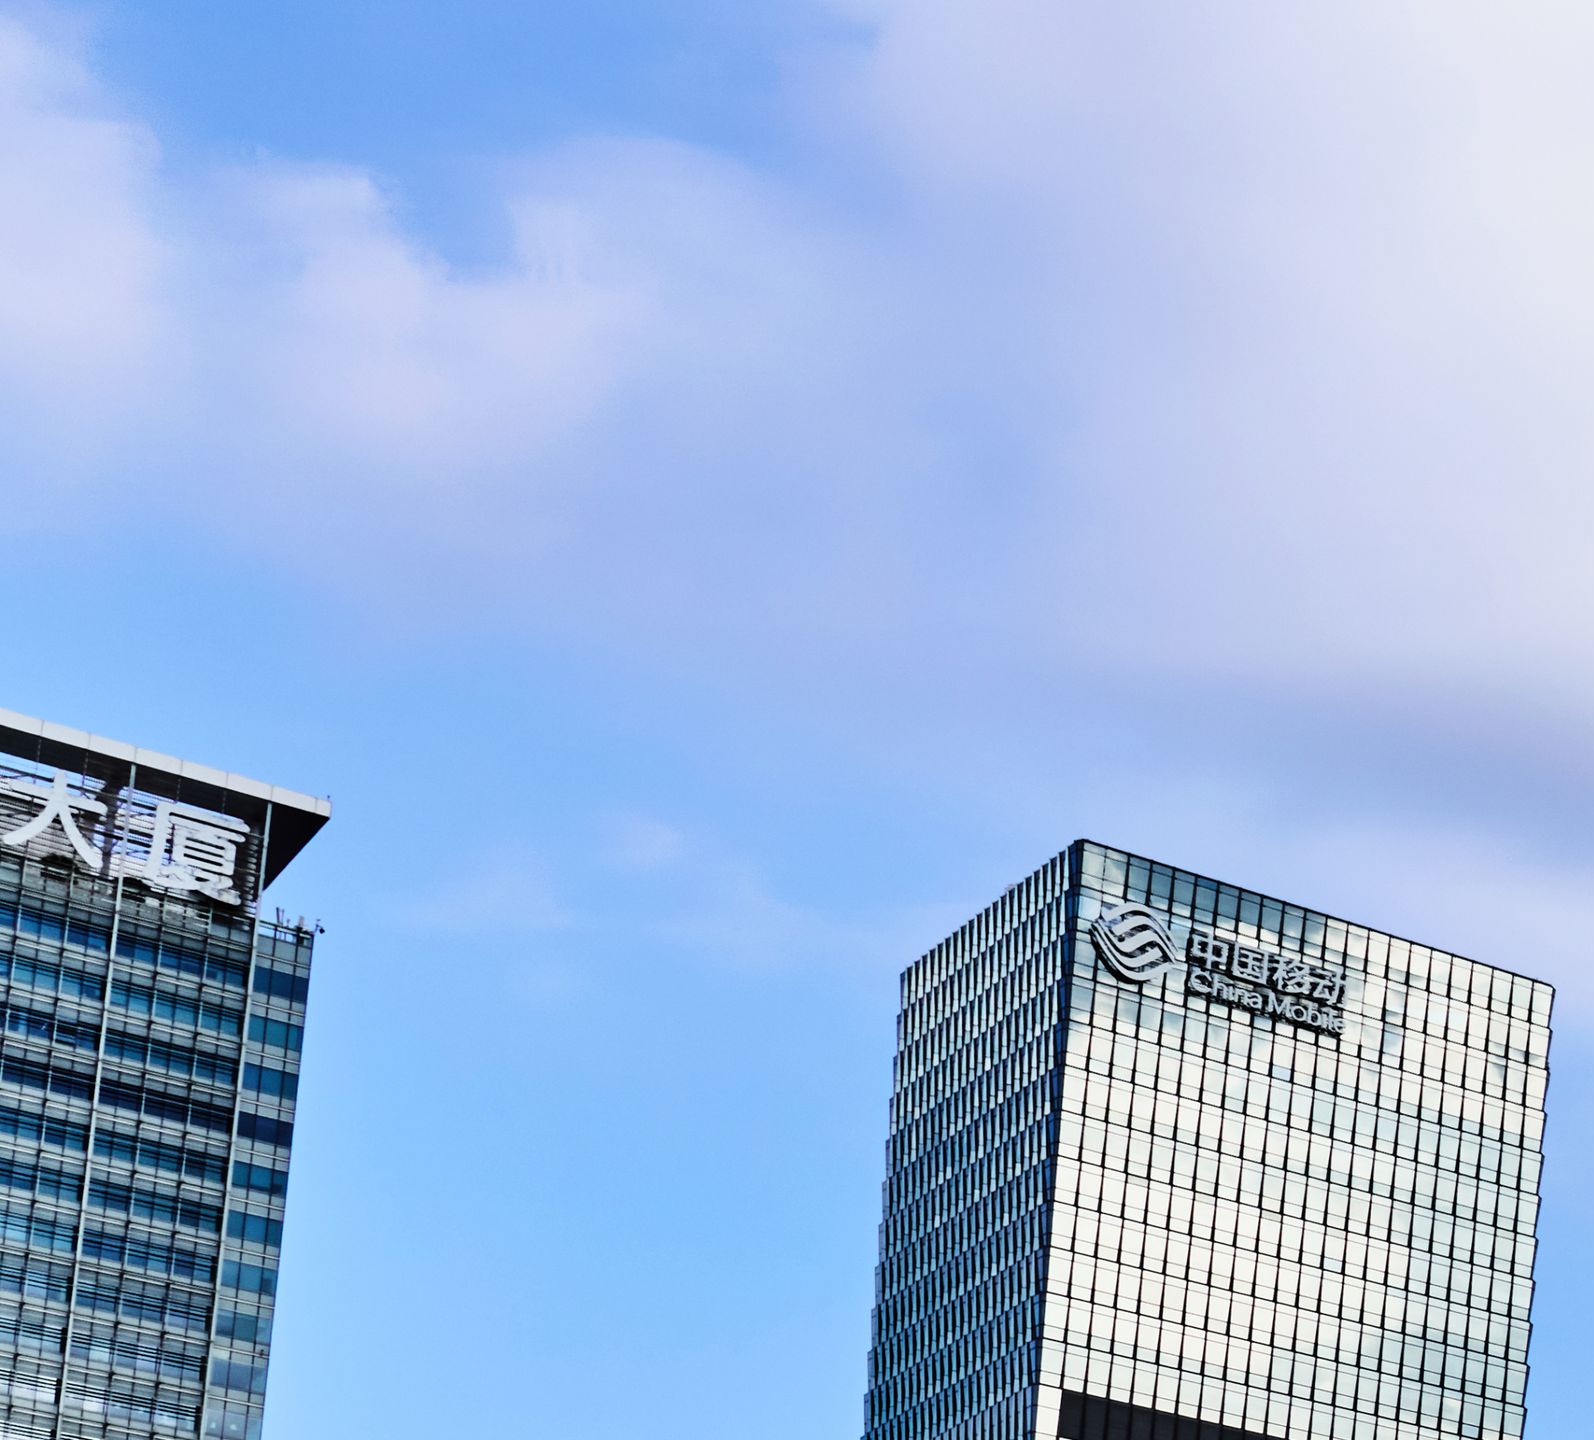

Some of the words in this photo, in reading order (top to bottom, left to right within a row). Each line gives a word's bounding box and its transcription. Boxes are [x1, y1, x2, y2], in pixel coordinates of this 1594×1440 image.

[3, 771, 250, 906] 大厦
[1190, 970, 1262, 1007] China
[1267, 990, 1347, 1034] Mobile
[1192, 933, 1348, 1007] 中国移动
